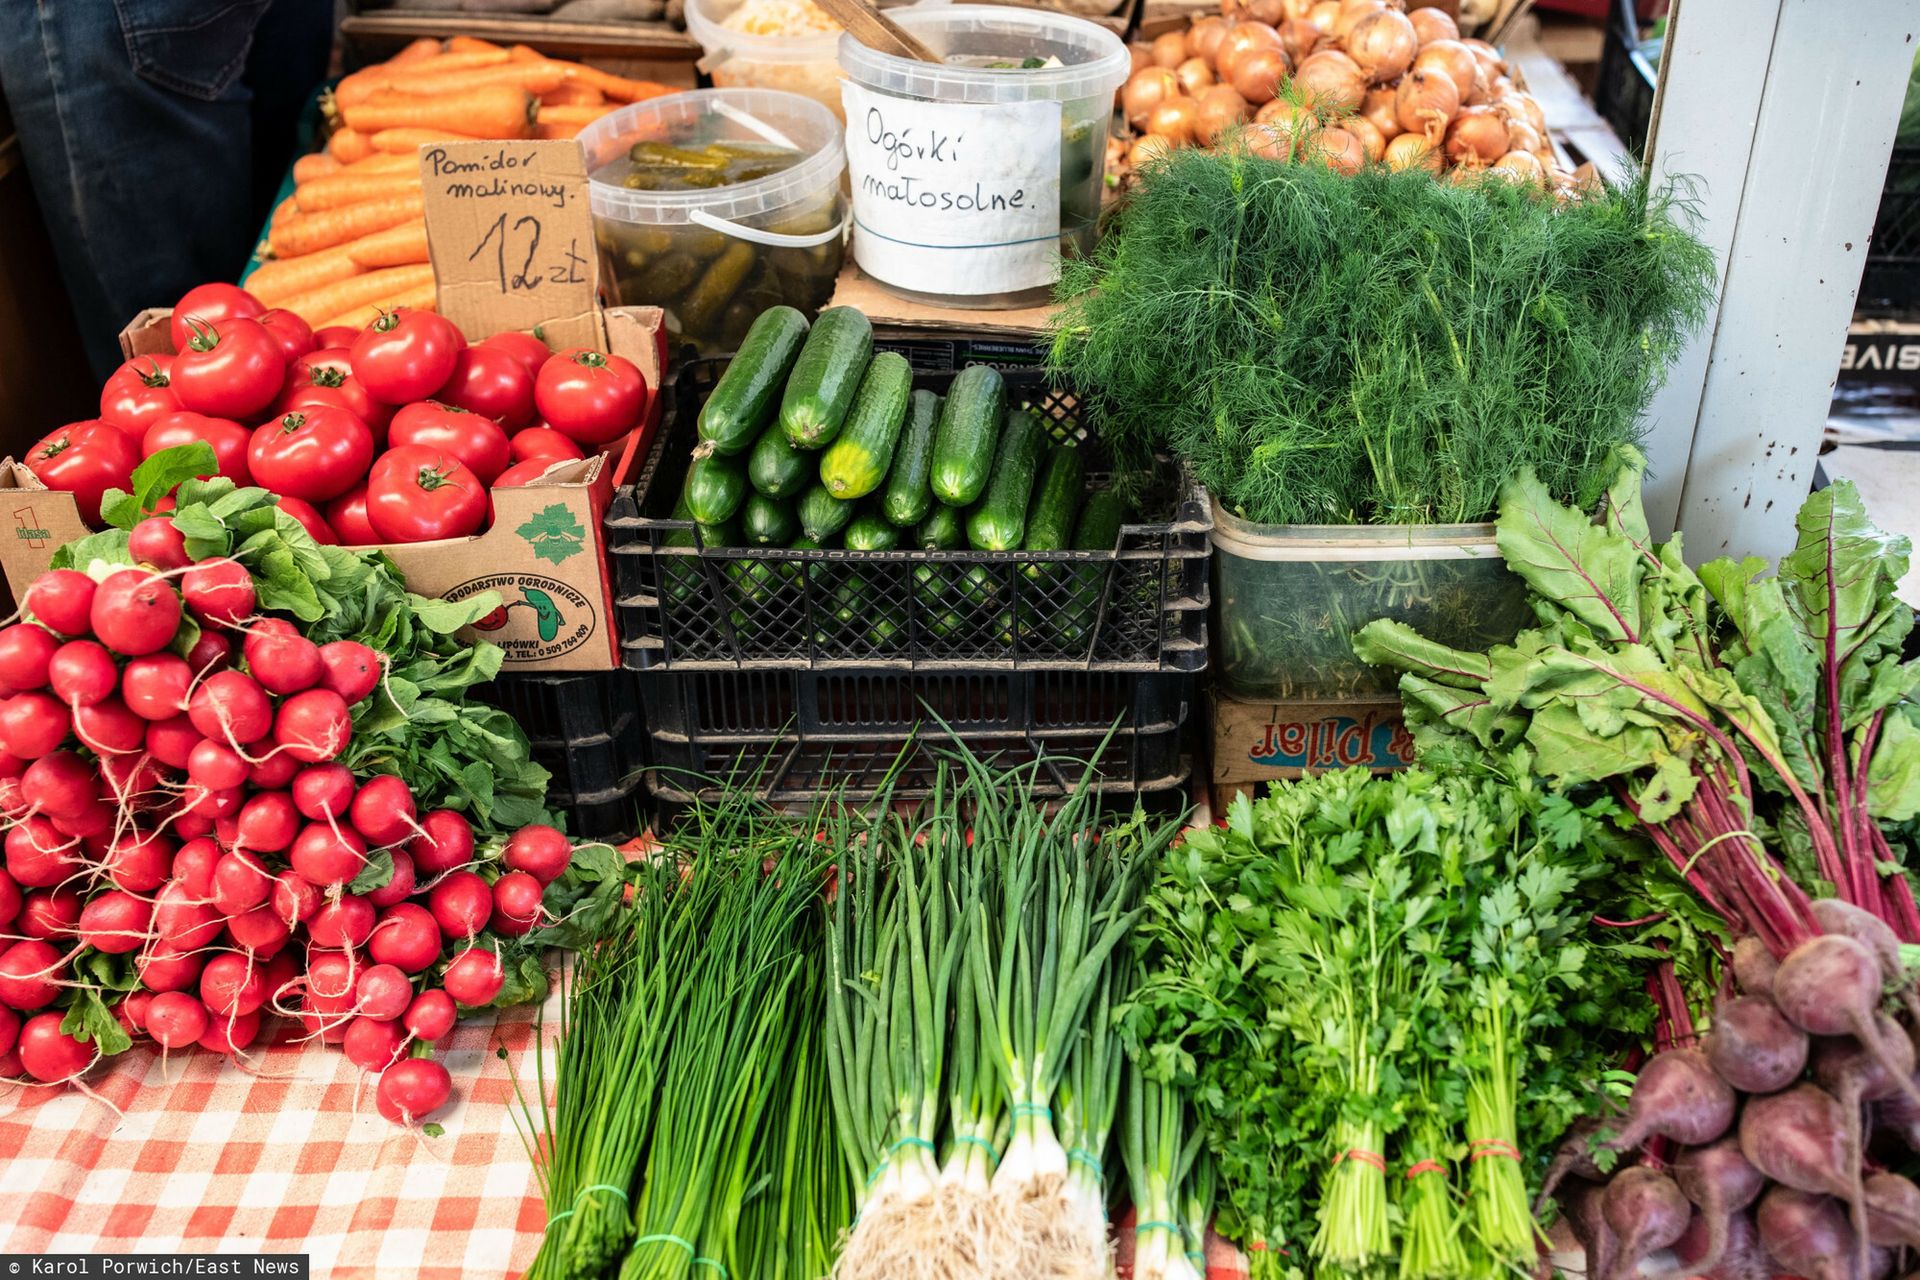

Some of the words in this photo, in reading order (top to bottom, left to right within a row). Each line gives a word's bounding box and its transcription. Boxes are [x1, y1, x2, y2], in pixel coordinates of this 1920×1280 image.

[867, 107, 966, 170] Ogórki
[425, 149, 537, 176] Pomidor
[447, 178, 575, 208] malinowy.
[863, 174, 1036, 212] małosolne.
[469, 212, 543, 295] 12
[549, 238, 588, 283] zł
[13, 506, 45, 549] 1
[446, 577, 514, 603] SPODARSTWO
[518, 576, 586, 609] OGRODNICZE
[546, 643, 562, 655] 509
[1250, 711, 1377, 767] Pilar
